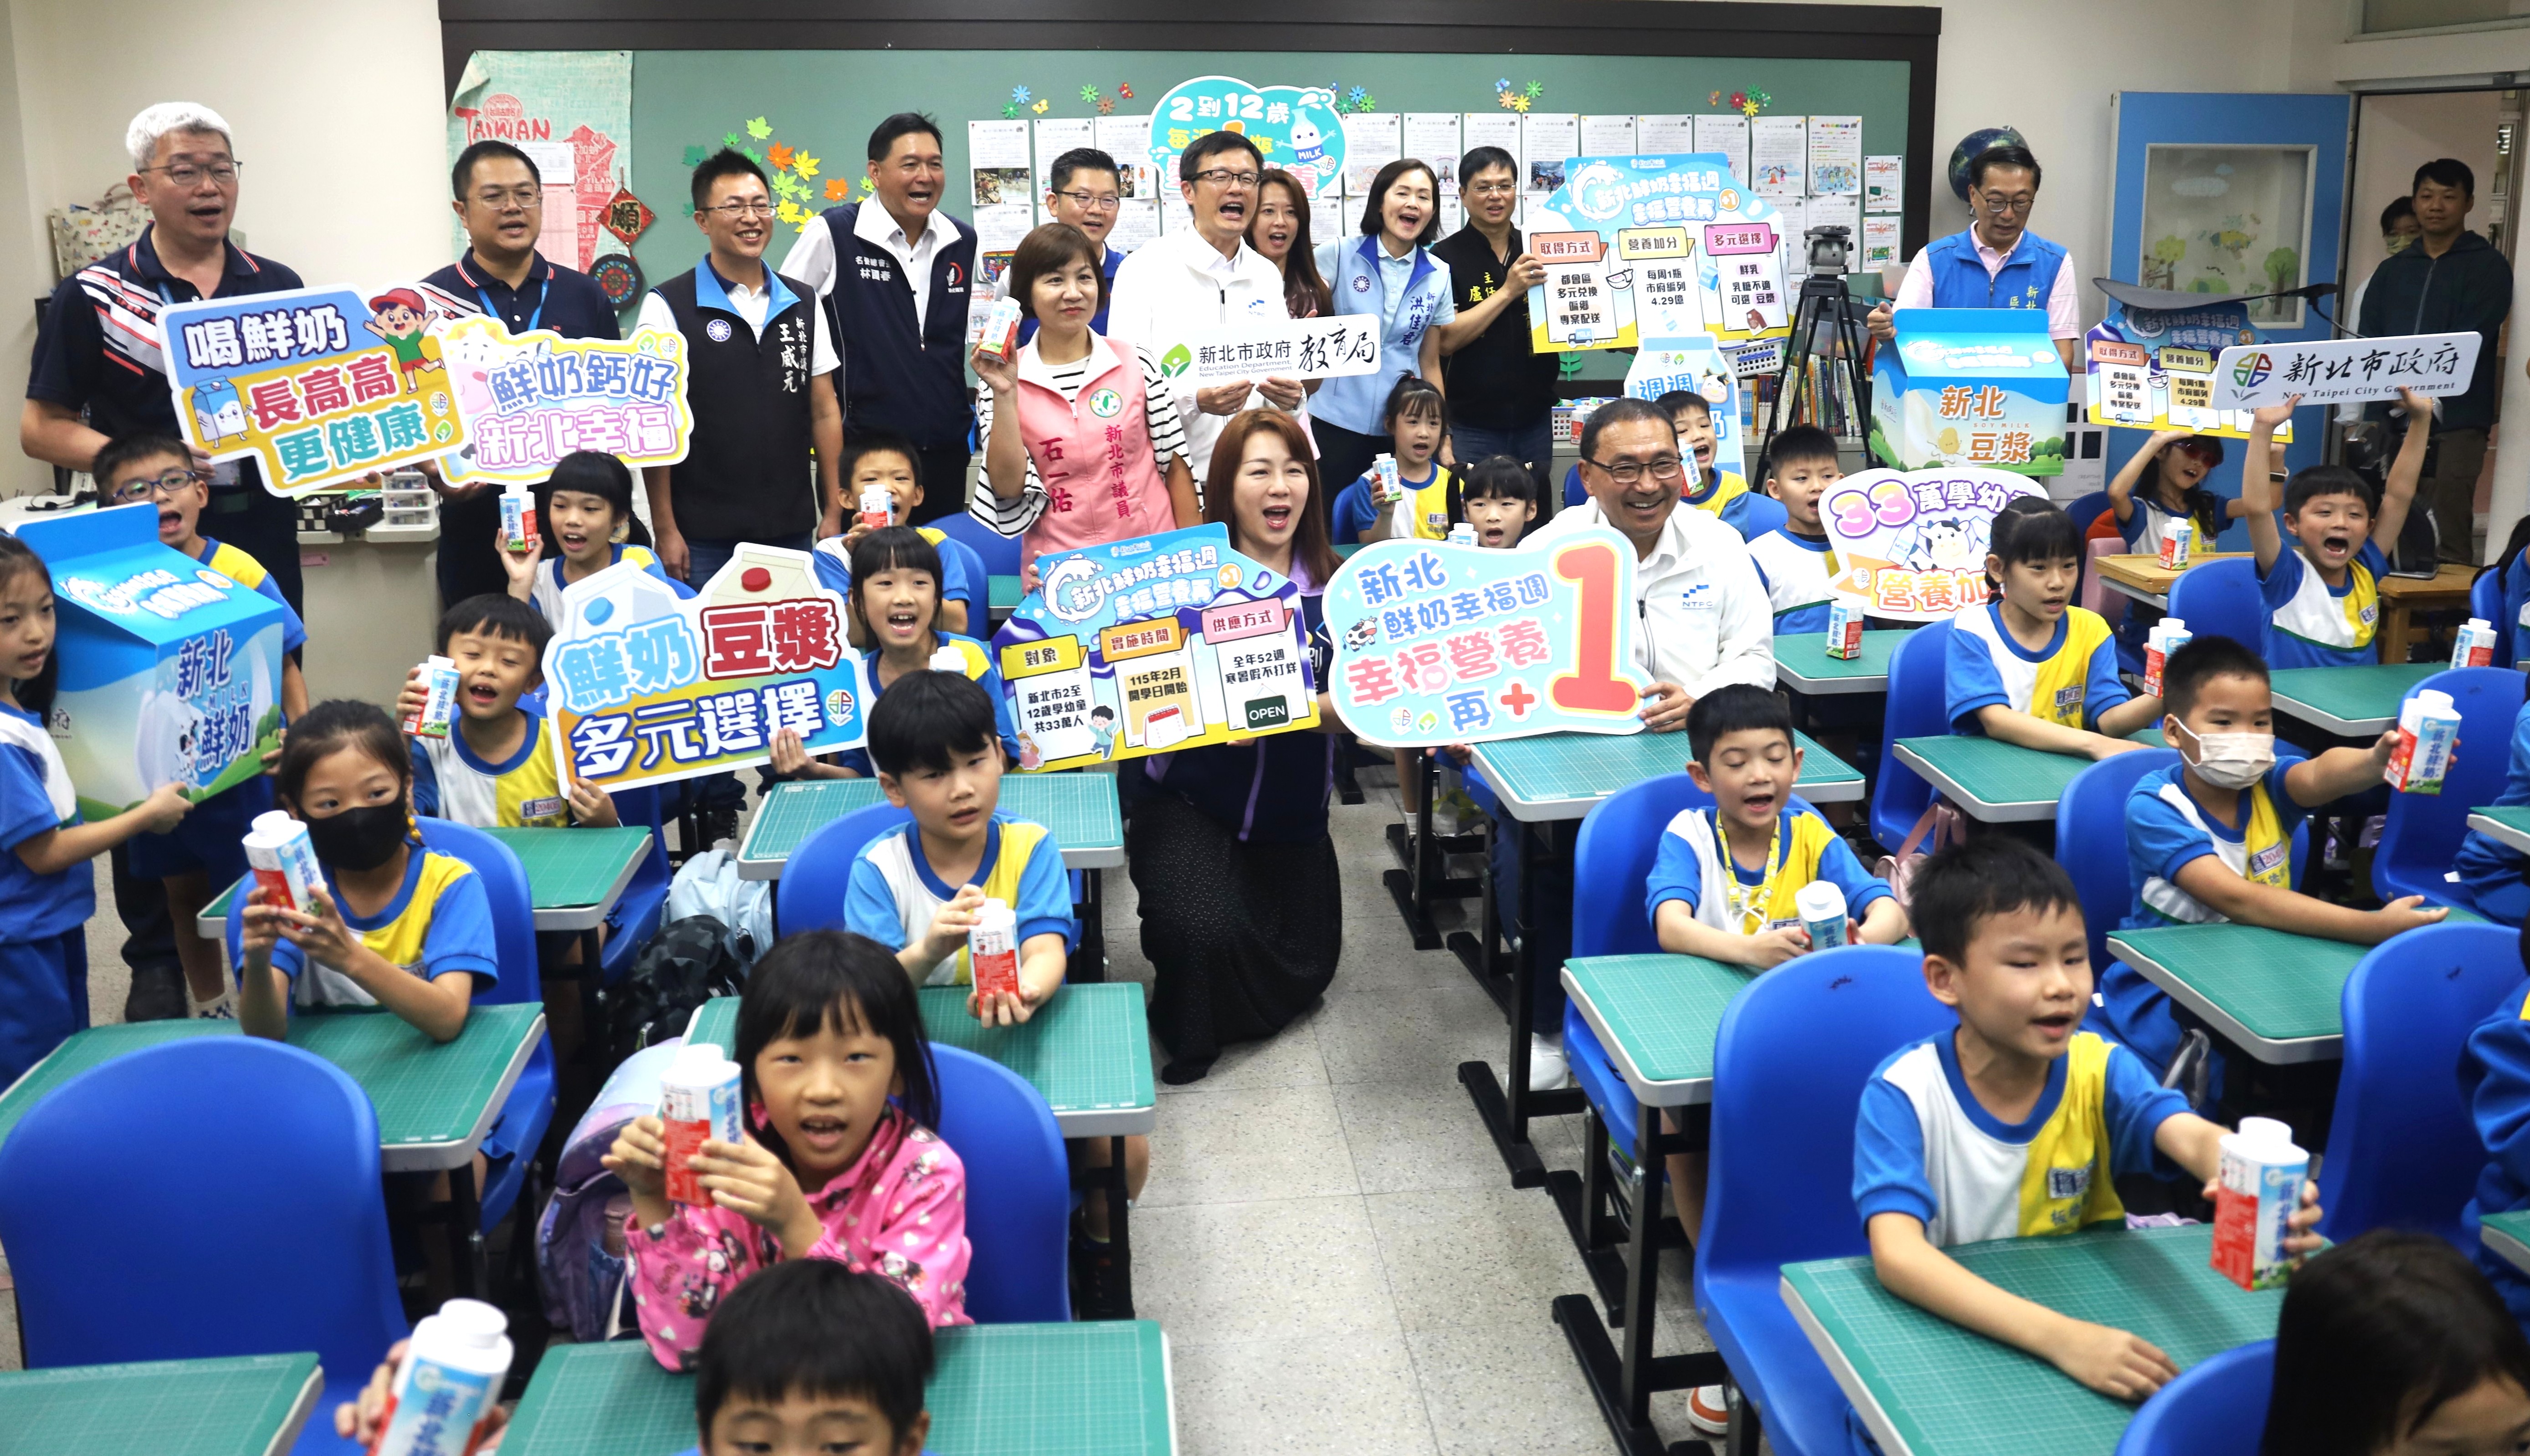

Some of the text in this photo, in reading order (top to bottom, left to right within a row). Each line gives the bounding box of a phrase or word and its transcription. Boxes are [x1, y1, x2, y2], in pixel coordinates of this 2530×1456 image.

[1169, 92, 1289, 124] 2到12歲
[455, 107, 550, 147] TAIWAN
[1298, 147, 1322, 160] MILK
[1596, 171, 1720, 209] 新北鮮奶幸福週
[1721, 193, 1736, 205] +1
[1632, 195, 1716, 222] 幸福營養再
[1540, 241, 1591, 255] 取得方式
[1628, 237, 1677, 250] 營養加分
[1714, 233, 1762, 246] 多元選擇
[1562, 274, 1591, 285] 都會區
[1648, 268, 1682, 279] 每周1瓶
[1740, 264, 1759, 275] 鮮乳
[1469, 286, 1484, 302] 盧
[1557, 286, 1598, 298] 多元兌換
[1646, 281, 1685, 293] 市府編列
[1732, 281, 1771, 291] 乳糖不適
[1569, 300, 1589, 311] 偏鄉
[1651, 295, 1684, 306] 4.29億
[1731, 293, 1775, 305] 可選 豆漿
[2010, 296, 2019, 309] 區
[1560, 313, 1600, 325] 專案配送
[184, 306, 348, 367] 喝鮮奶
[779, 323, 799, 393] 王威元
[1199, 323, 1375, 373] 新北市政府 教育局
[2099, 347, 2139, 360] 取得方式
[1199, 360, 1292, 372] Education Department,
[2166, 353, 2205, 366] 營養加分
[2282, 342, 2460, 386] 新北市政府
[1251, 366, 1292, 374] Government
[488, 348, 679, 414] 鮮奶鈣好
[2313, 388, 2350, 398] Taipei
[2355, 386, 2379, 396] City
[2385, 382, 2455, 393] Goernment
[251, 353, 397, 431] 長高高
[1940, 386, 2006, 418] 新北
[276, 405, 428, 480] 更健康
[475, 404, 676, 469] 新北幸福
[1968, 431, 2032, 463] 豆漿
[1039, 437, 1074, 513] 石一佑
[1104, 424, 1131, 519] 新北市議員
[1895, 542, 1910, 552] MILK
[1072, 545, 1218, 609] 新北鮮奶幸福週
[1221, 568, 1239, 582] +1
[1358, 552, 1448, 606] 新北
[1115, 578, 1214, 620] 幸福營養再
[1383, 573, 1550, 640] 鮮奶幸福週
[1213, 609, 1273, 632] 供應方式
[1111, 628, 1169, 650] 實施時間
[177, 629, 232, 700] 新北
[559, 604, 838, 710] 鮮奶 豆漿
[1025, 647, 1057, 666] 對象
[1234, 650, 1285, 669] 全年52週
[1347, 620, 1550, 707] 幸福營養
[1130, 667, 1182, 686] 115年2月
[1225, 662, 1297, 685] 寒暑假不打烊
[208, 681, 249, 710] MILK
[1028, 685, 1082, 705] 新北市2至
[1128, 682, 1188, 702] 開學日開始
[1027, 700, 1087, 719] 12歲學幼童
[1248, 705, 1286, 721] OPEN
[571, 681, 823, 777] 多元選擇
[1034, 715, 1085, 734] 共33萬人
[200, 703, 253, 773] 鮮奶
